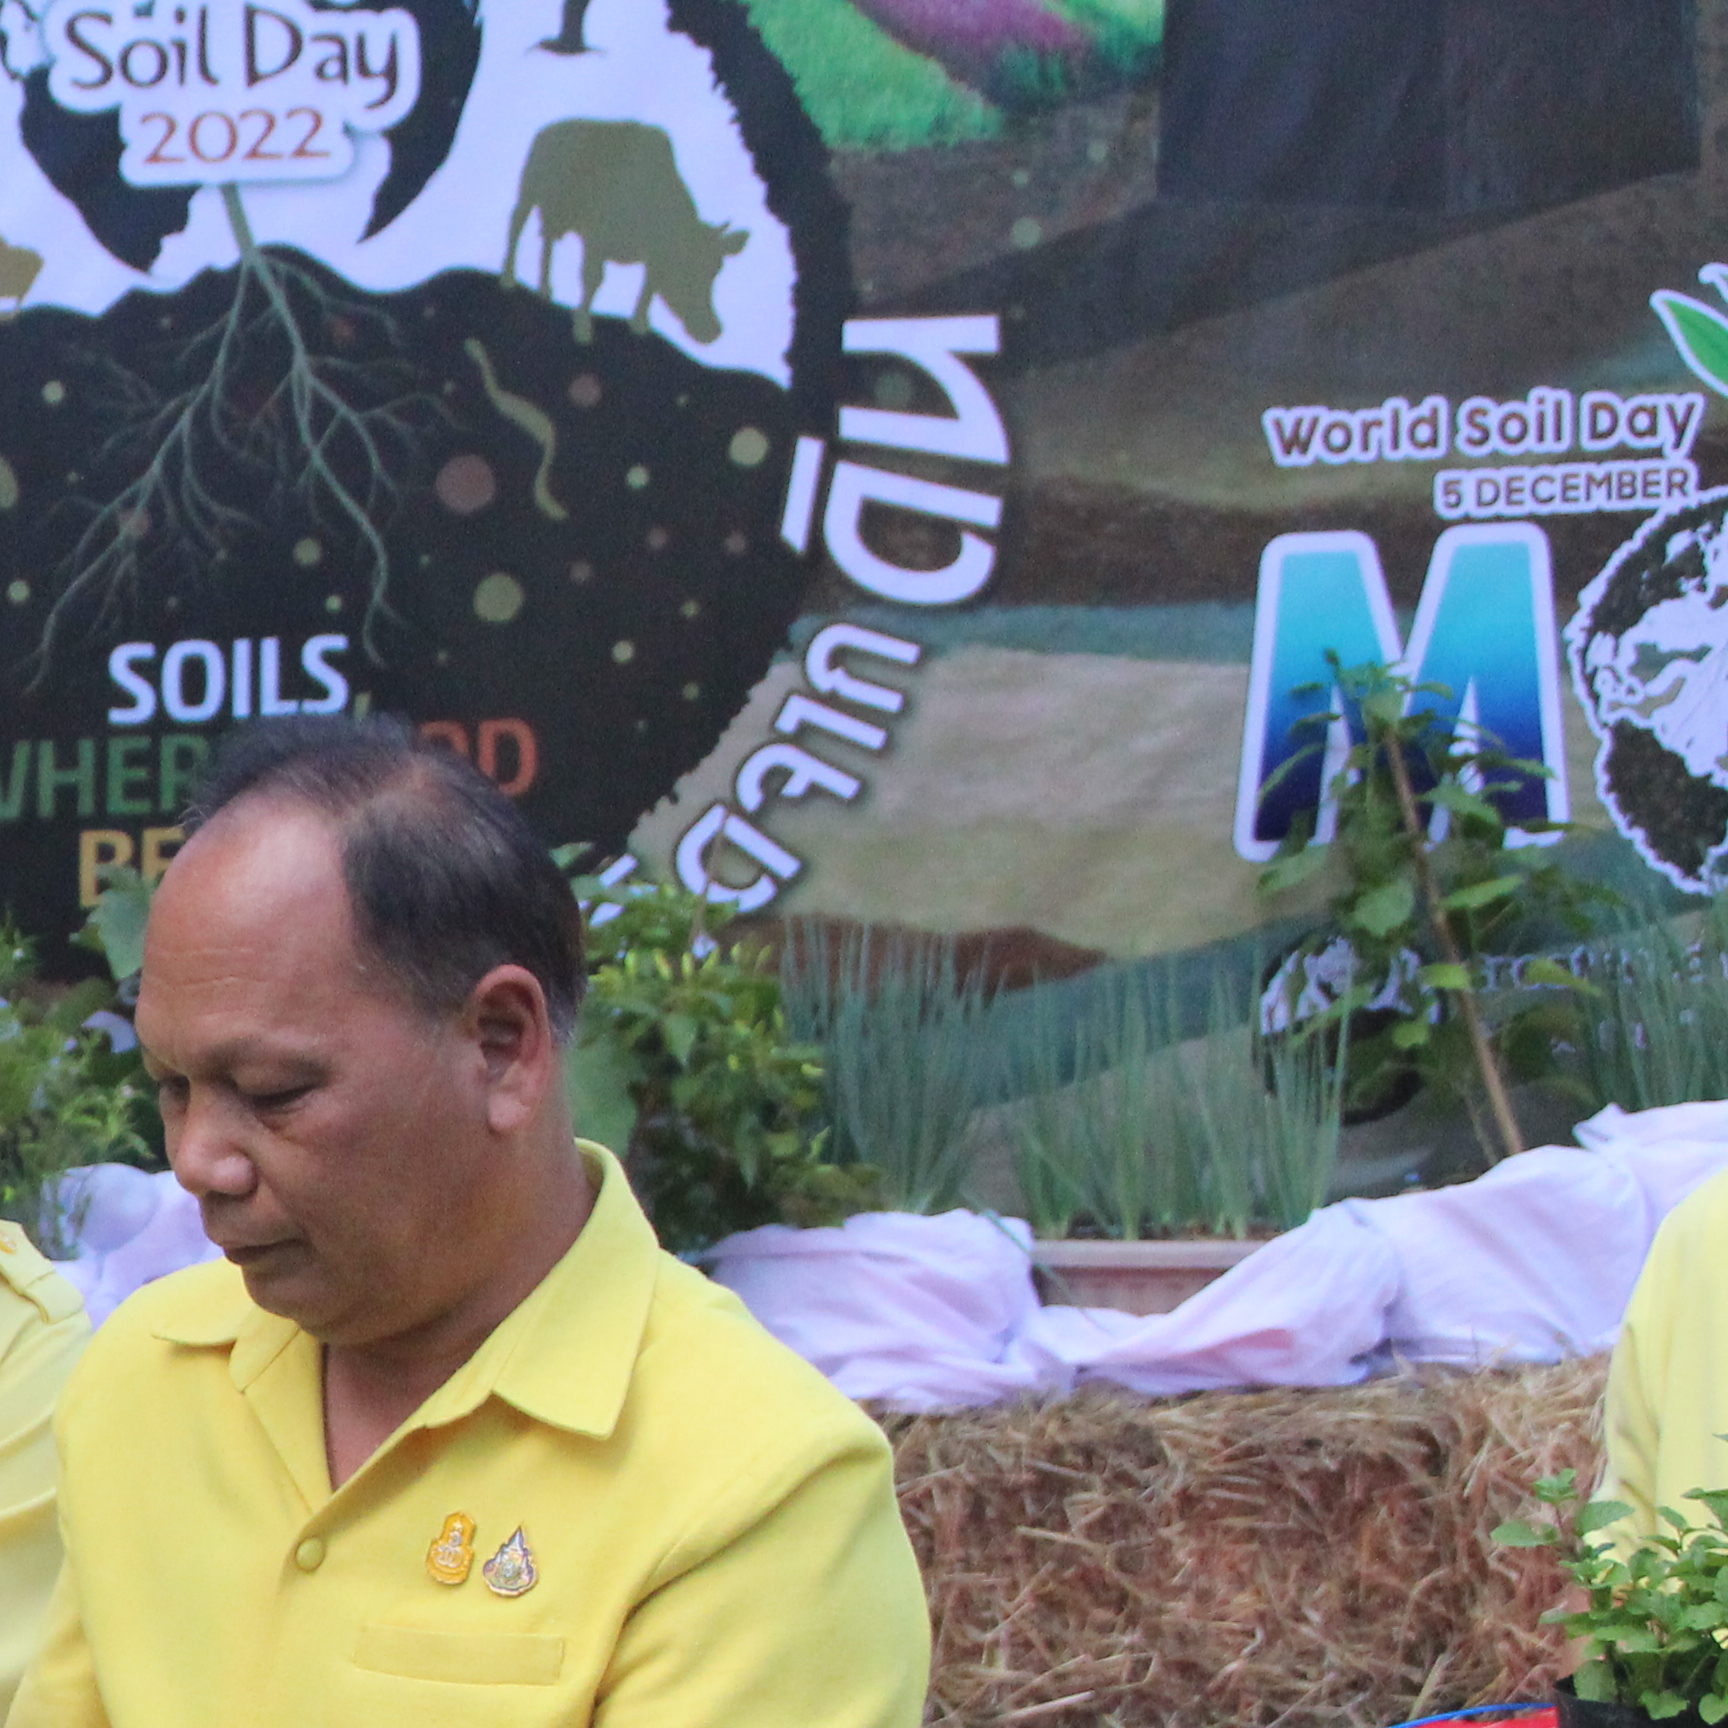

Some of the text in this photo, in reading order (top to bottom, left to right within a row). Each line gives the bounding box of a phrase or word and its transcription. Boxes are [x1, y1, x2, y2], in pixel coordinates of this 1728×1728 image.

[64, 6, 400, 110] Soil Day
[140, 106, 332, 165] 2022
[1271, 395, 1697, 456] World Soil Day
[1443, 466, 1690, 509] 5 DECEMBER
